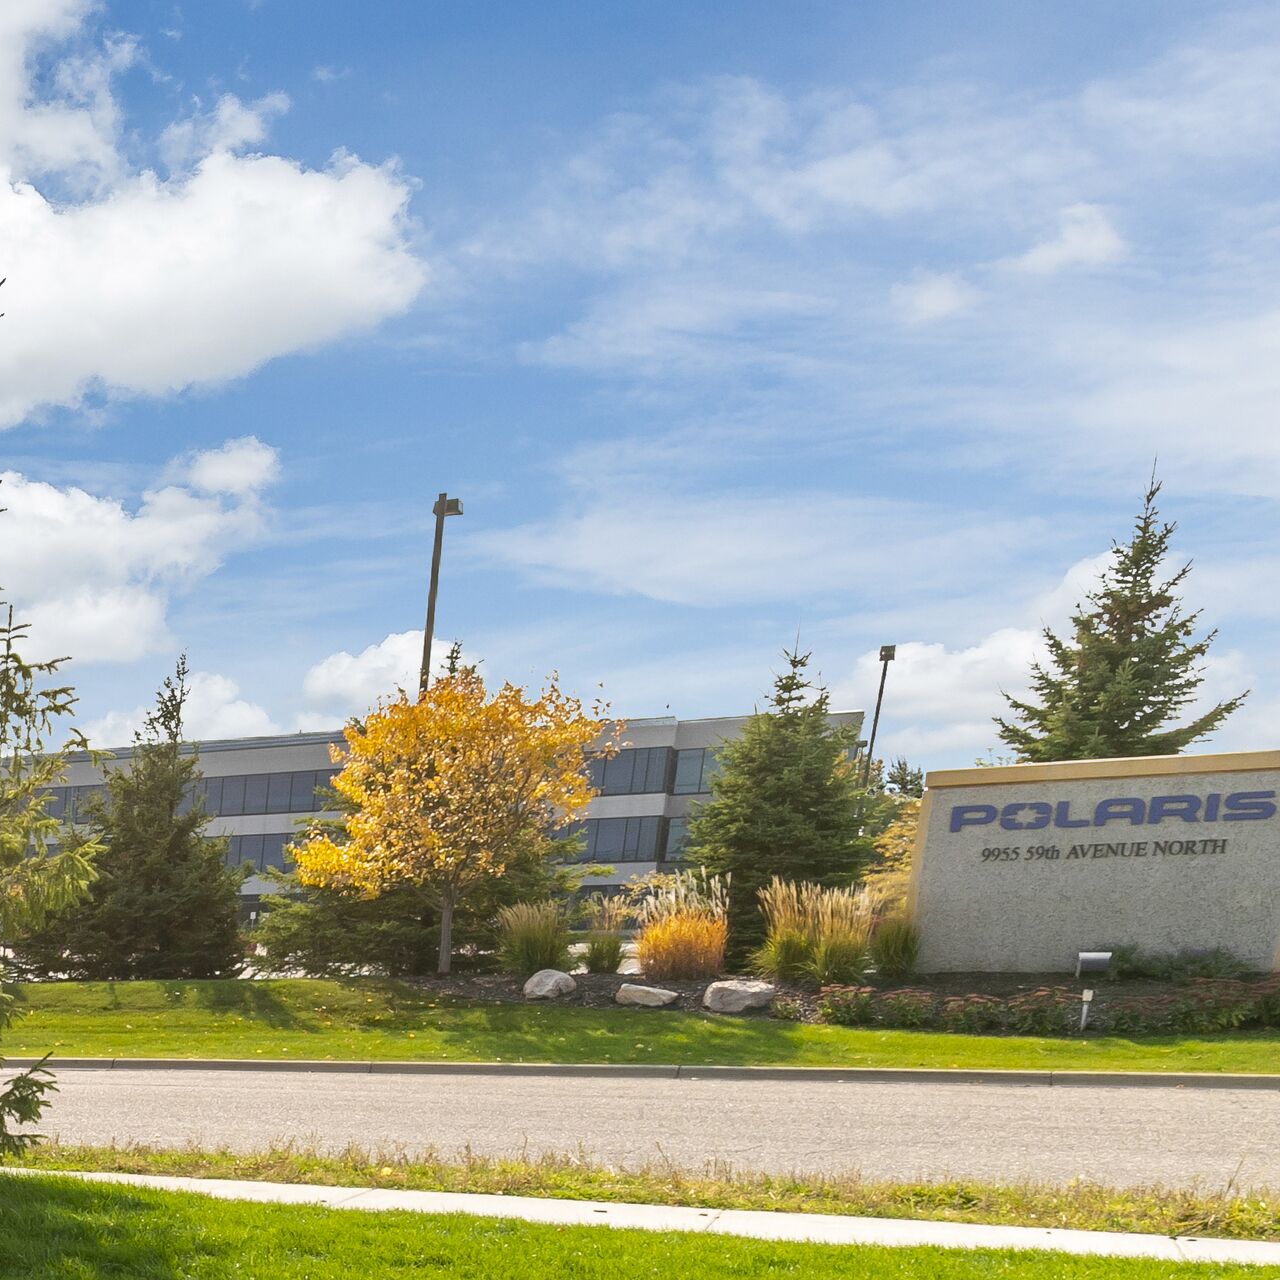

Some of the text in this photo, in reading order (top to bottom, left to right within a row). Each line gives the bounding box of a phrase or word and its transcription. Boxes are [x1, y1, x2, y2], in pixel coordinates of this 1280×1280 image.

[949, 790, 1277, 833] POLARIS
[981, 838, 1228, 862] 9955 59th AVENUE NORTH
